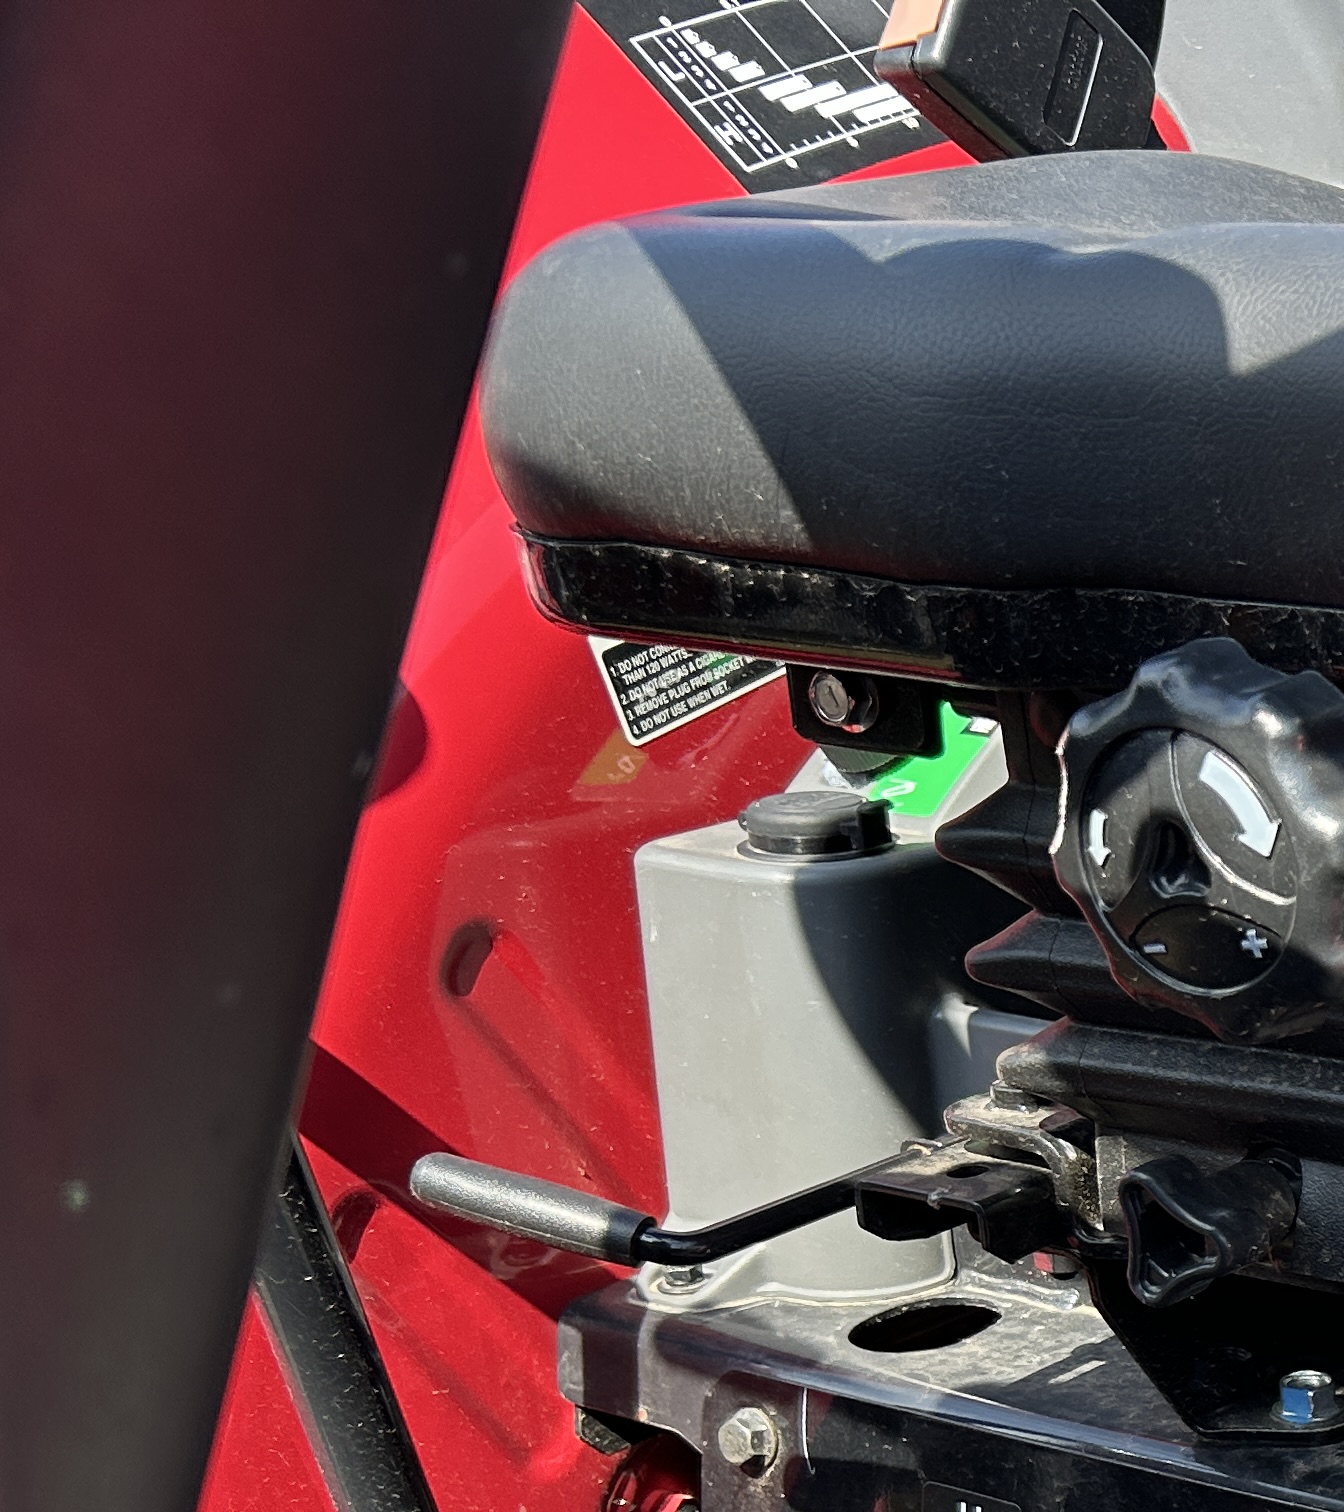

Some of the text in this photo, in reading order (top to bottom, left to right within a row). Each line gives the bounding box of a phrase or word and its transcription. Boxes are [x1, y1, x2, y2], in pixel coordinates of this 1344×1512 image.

[618, 659, 632, 675] DO
[631, 652, 650, 667] NOT
[621, 669, 647, 686] THAN
[646, 660, 661, 676] 120
[620, 693, 630, 705] 2.
[628, 686, 643, 702] DO
[677, 665, 689, 679] AS
[688, 660, 696, 673] A
[634, 692, 670, 717] REMOVE
[668, 682, 691, 701] PLUG
[631, 680, 731, 736] 4. DO NOT USE WHEN WET.
